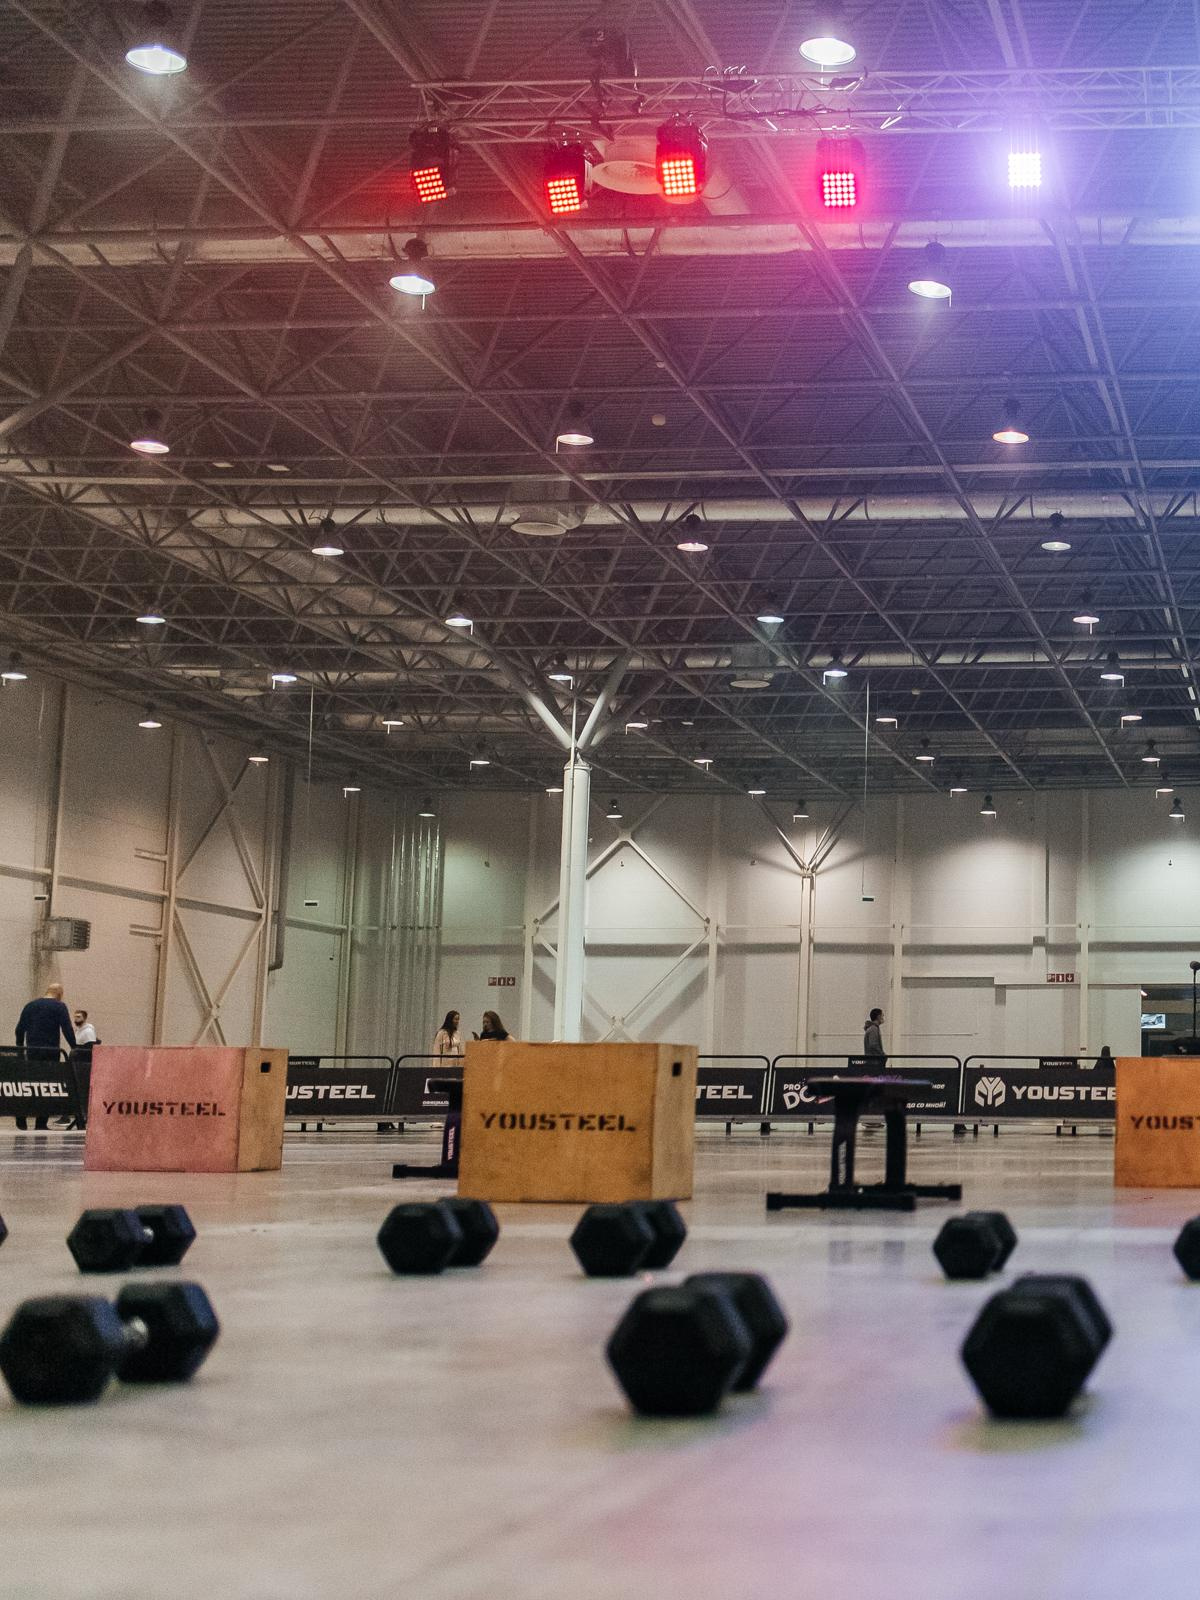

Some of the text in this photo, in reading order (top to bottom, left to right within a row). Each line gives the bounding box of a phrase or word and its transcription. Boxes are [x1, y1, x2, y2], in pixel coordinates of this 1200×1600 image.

[286, 1085, 376, 1099] USTEEL
[696, 1085, 753, 1099] TEEL
[1012, 1085, 1117, 1100] YOUSTEE
[103, 1101, 226, 1117] YOUSTEEL
[480, 1112, 636, 1132] YOUSTEEL
